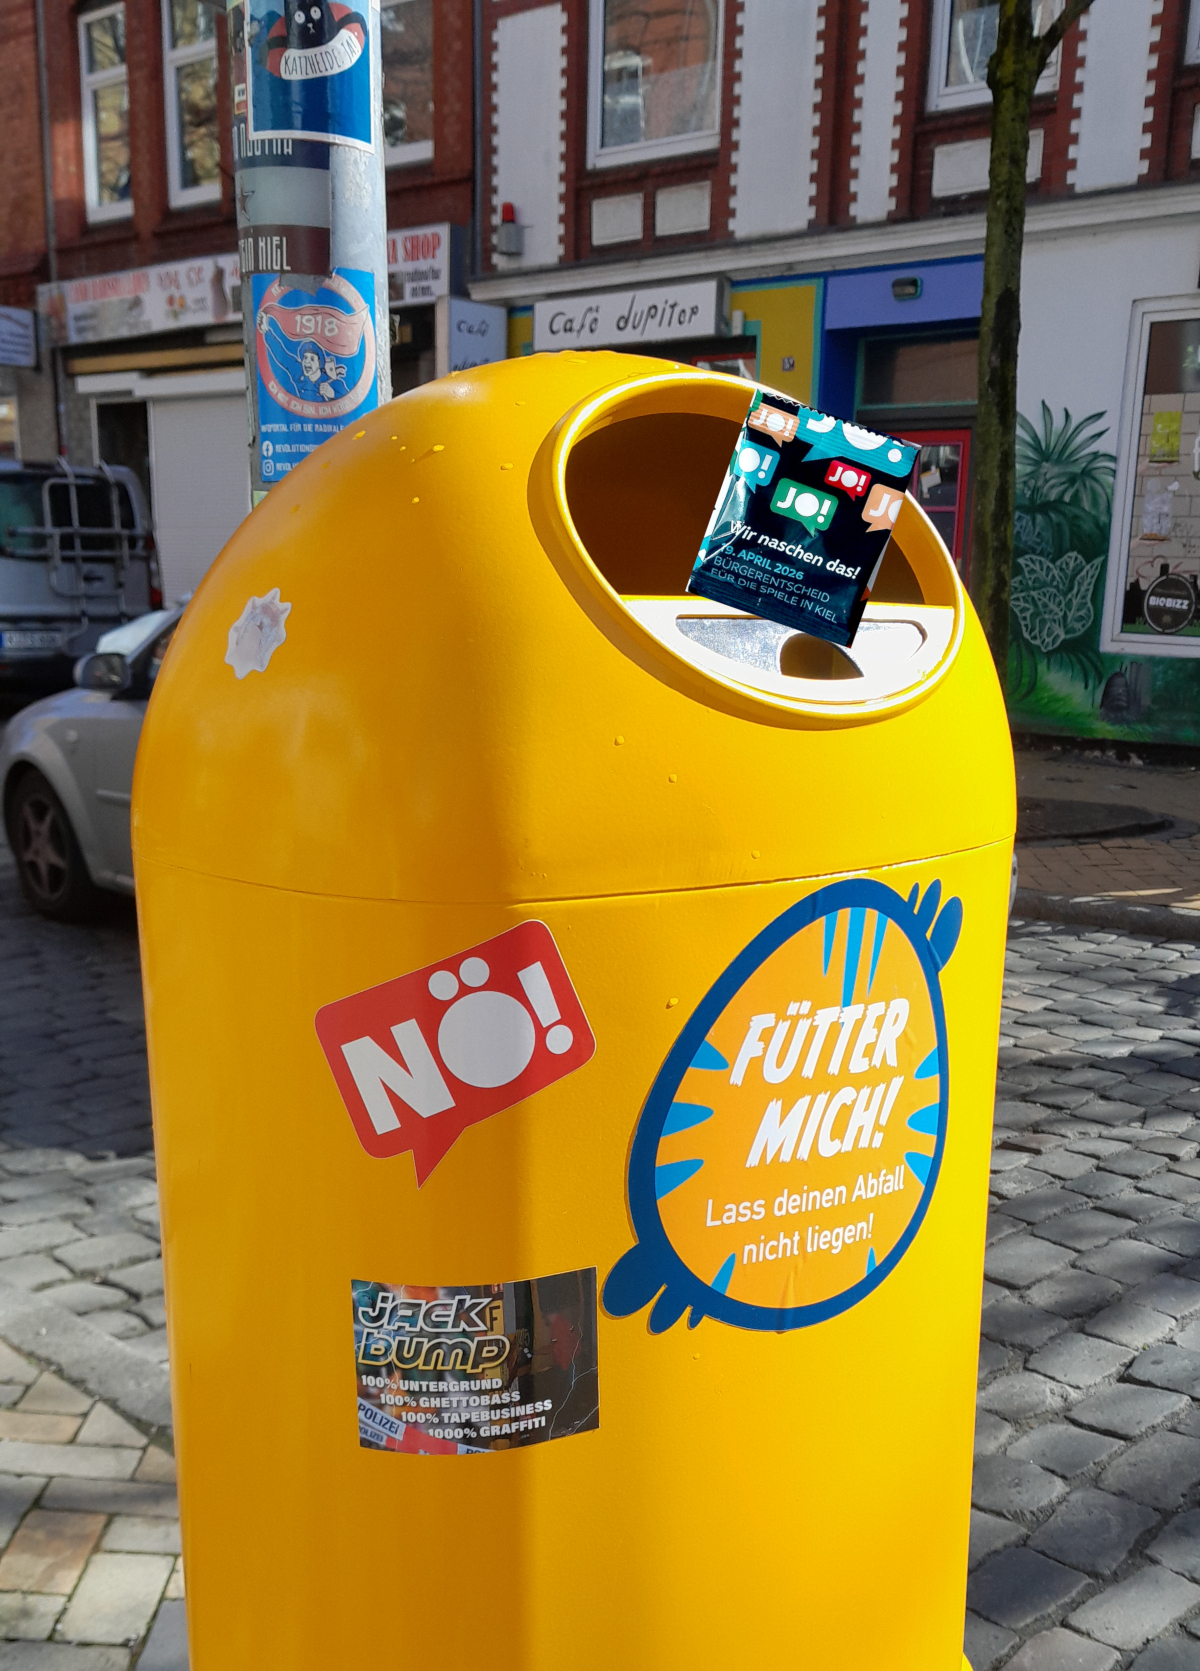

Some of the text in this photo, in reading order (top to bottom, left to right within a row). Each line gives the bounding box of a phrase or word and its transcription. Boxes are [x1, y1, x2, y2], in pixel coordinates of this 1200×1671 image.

[258, 236, 292, 271] KIEL
[403, 232, 442, 262] SHOP
[295, 314, 338, 336] 1918
[549, 305, 600, 339] Café
[752, 408, 794, 437] JO!
[828, 466, 867, 492] JO!
[776, 486, 832, 524] JO!
[730, 520, 861, 580] Wir naschen das!
[737, 549, 772, 570] APRIL
[773, 562, 804, 580] 2026
[711, 567, 838, 624] FÜR DIE SPIELE IN KIEL
[713, 555, 830, 603] BÜRGERENTSCHEID
[1149, 596, 1190, 610] BIOBIZZ
[340, 957, 574, 1136] NÖ!
[729, 998, 910, 1087] FÜTTER
[745, 1075, 904, 1168] MICH!
[706, 1164, 905, 1227] Lass deinen Abfall
[742, 1213, 874, 1264] nicht liegen!
[361, 1375, 503, 1392] 100% UNTERGRUND
[380, 1390, 521, 1408] 100% GHETTOBASS
[358, 1402, 400, 1435] POLIZEI
[401, 1399, 553, 1424] 100% TAPEBUSINESS
[428, 1428, 477, 1439] 1000%
[479, 1415, 546, 1438] GRAFFITI
